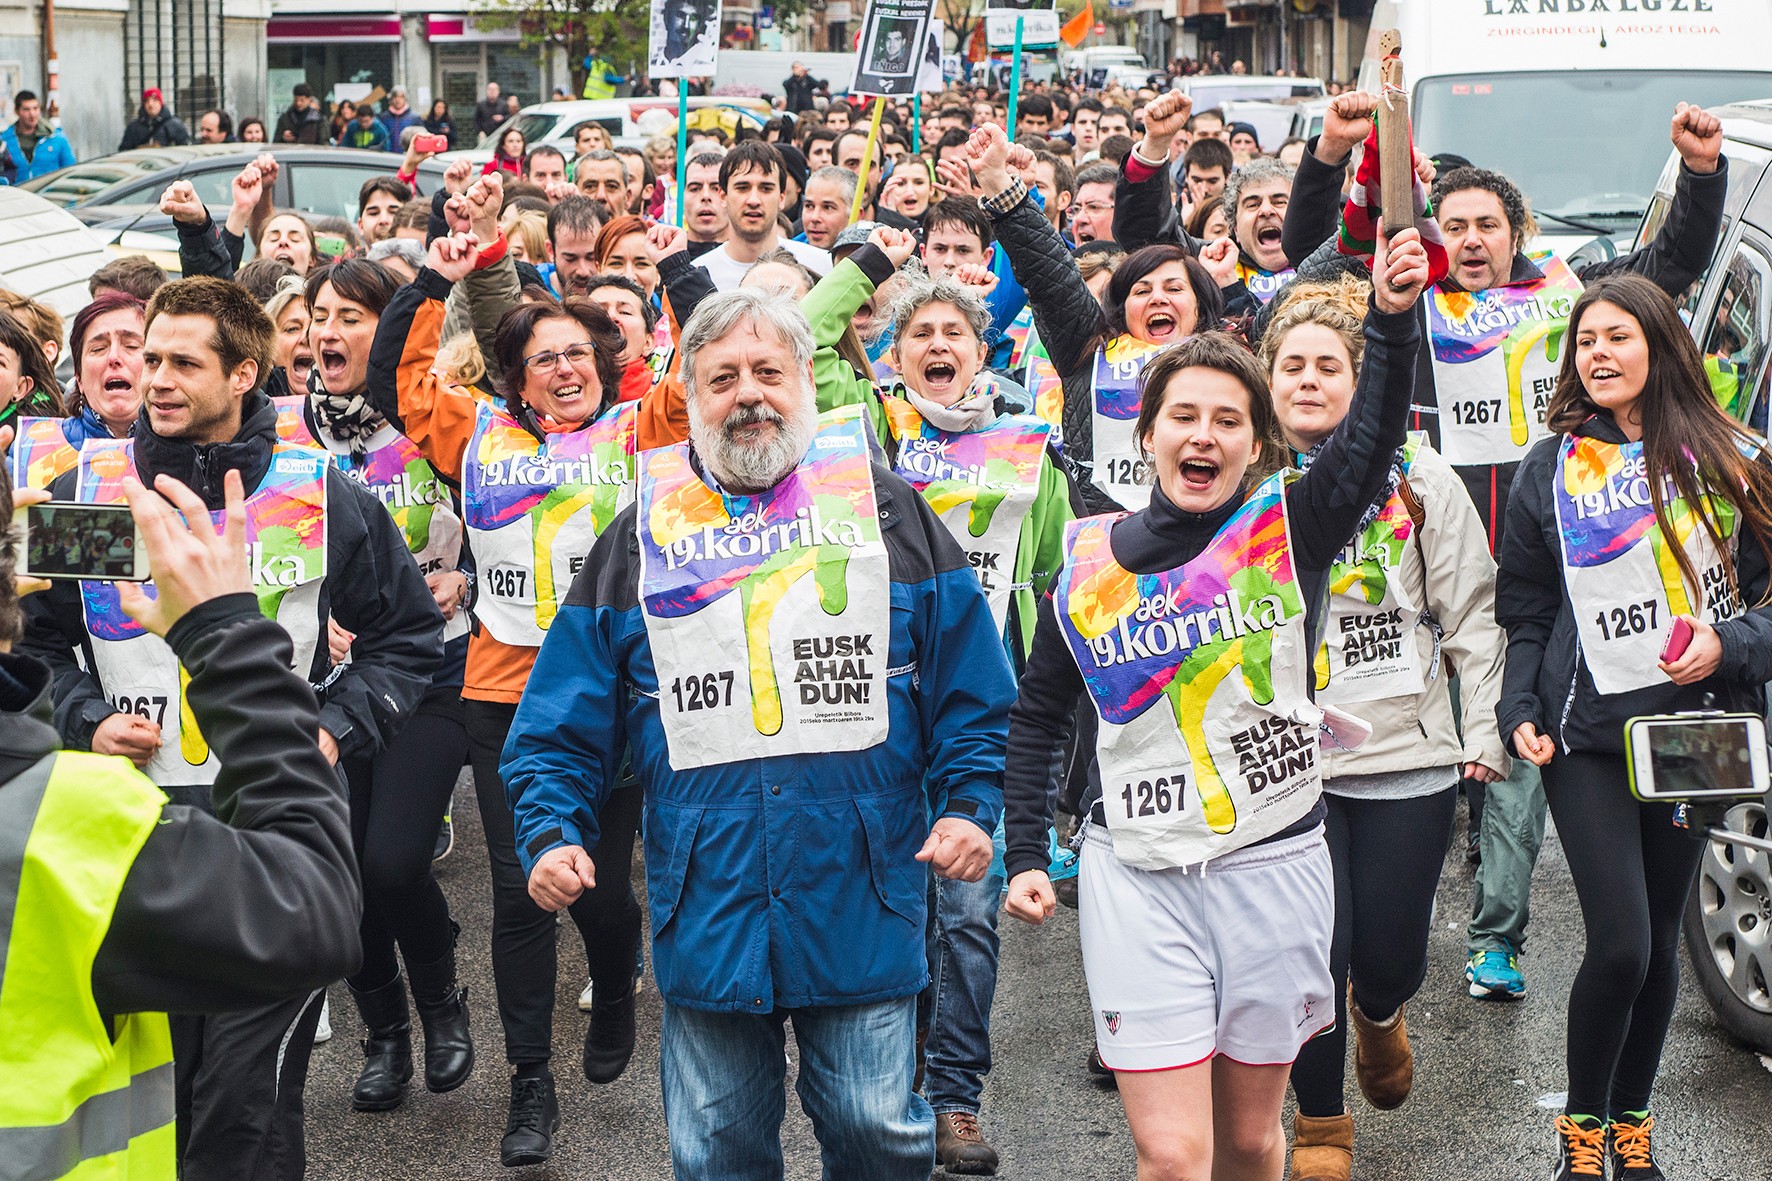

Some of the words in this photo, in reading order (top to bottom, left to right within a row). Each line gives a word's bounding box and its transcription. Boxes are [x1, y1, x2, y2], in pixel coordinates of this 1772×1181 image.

[1487, 26, 1596, 36] ZURGINDEGI
[1615, 25, 1721, 34] AROZTEGIA
[1442, 294, 1573, 336] 19.korrika
[1533, 376, 1561, 394] EUS
[1453, 399, 1502, 425] 1267
[912, 436, 951, 459] aek
[478, 452, 628, 487] 19.korrika
[1107, 459, 1148, 486] 126
[1621, 456, 1647, 479] ae
[724, 503, 768, 535] aek
[660, 506, 867, 572] 19.korrika
[487, 569, 526, 598] 1267
[1136, 582, 1180, 623] aek
[1084, 588, 1287, 669] 19.korrika
[1339, 607, 1403, 633] EUSK
[1596, 599, 1658, 641] 1267
[793, 634, 873, 660] EUSK
[1342, 626, 1402, 651] AHAL
[1345, 641, 1402, 667] DUN!
[793, 658, 873, 683] AHAL
[672, 670, 734, 712] 1267
[800, 682, 870, 705] DUN!
[1237, 728, 1315, 776] AHAL
[1246, 752, 1315, 796] DUN!
[1122, 774, 1186, 819] 1267
